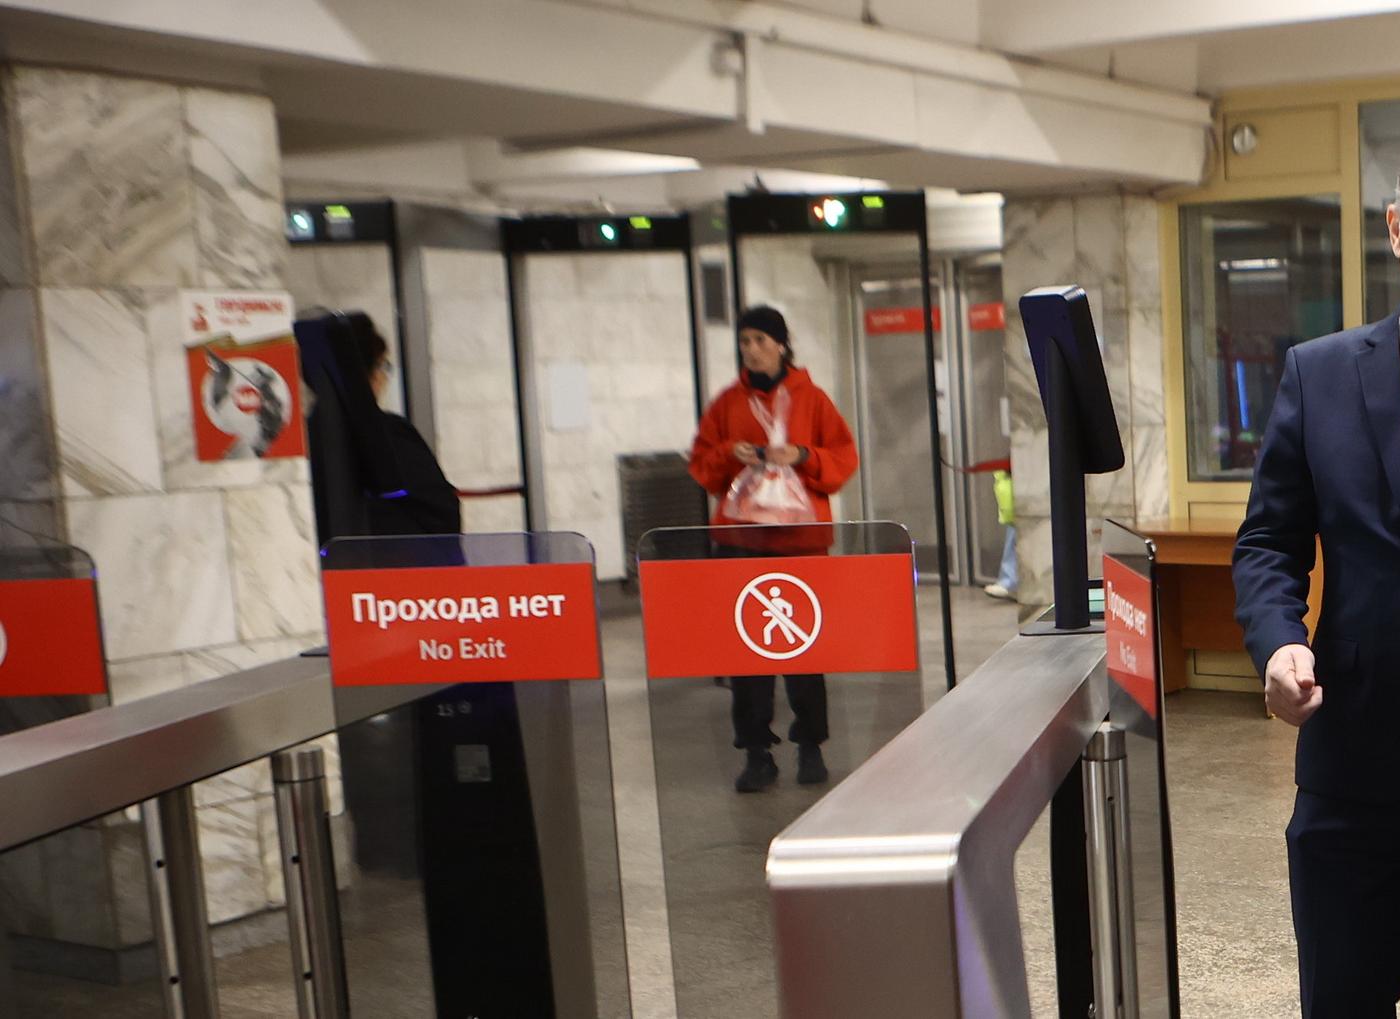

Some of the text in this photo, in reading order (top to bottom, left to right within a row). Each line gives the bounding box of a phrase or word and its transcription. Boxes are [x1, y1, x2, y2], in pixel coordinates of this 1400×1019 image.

[351, 592, 565, 629] Прохода нет
[1107, 580, 1147, 637] Прохода нет
[419, 637, 506, 660] No Exit
